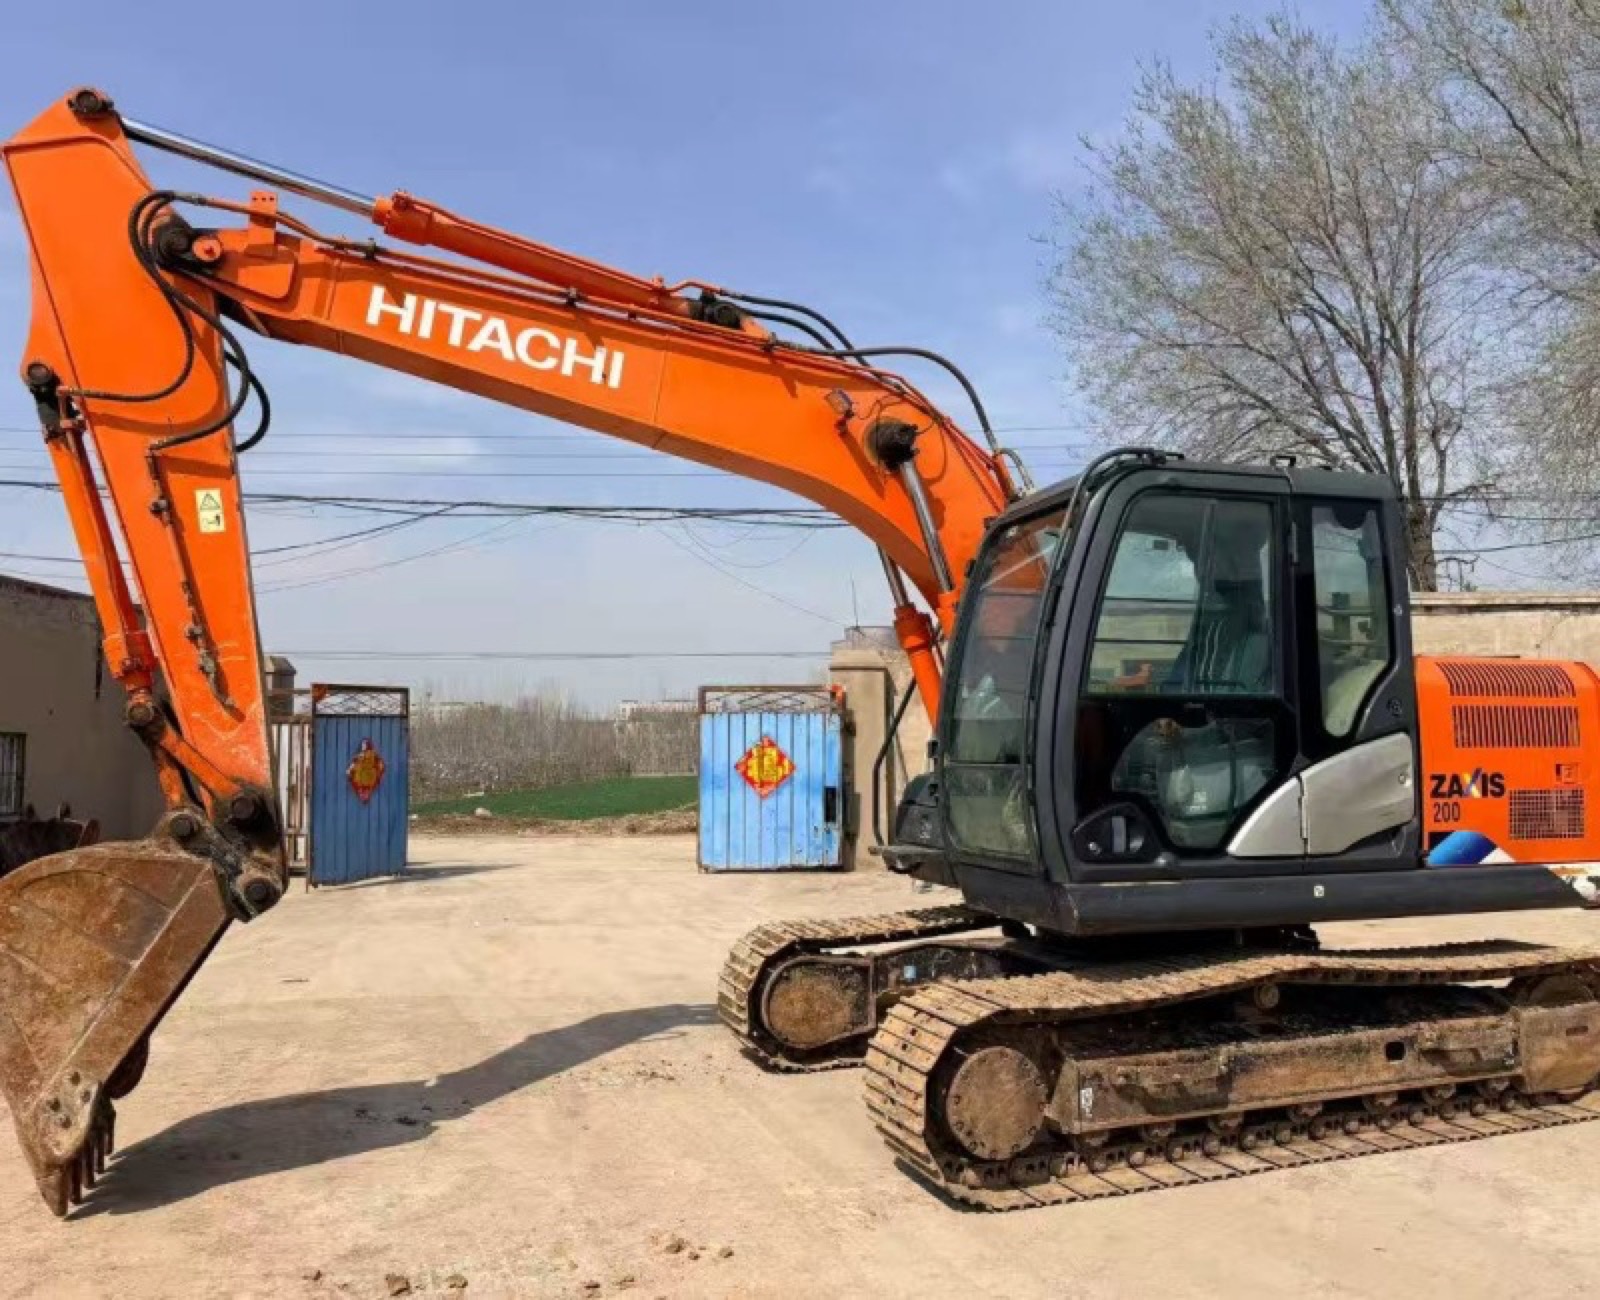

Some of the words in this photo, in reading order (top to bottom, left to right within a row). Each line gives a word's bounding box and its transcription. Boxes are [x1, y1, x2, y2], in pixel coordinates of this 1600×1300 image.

[366, 285, 625, 389] HITACHI
[1430, 768, 1505, 798] ZAXIS
[1433, 801, 1461, 823] 200
